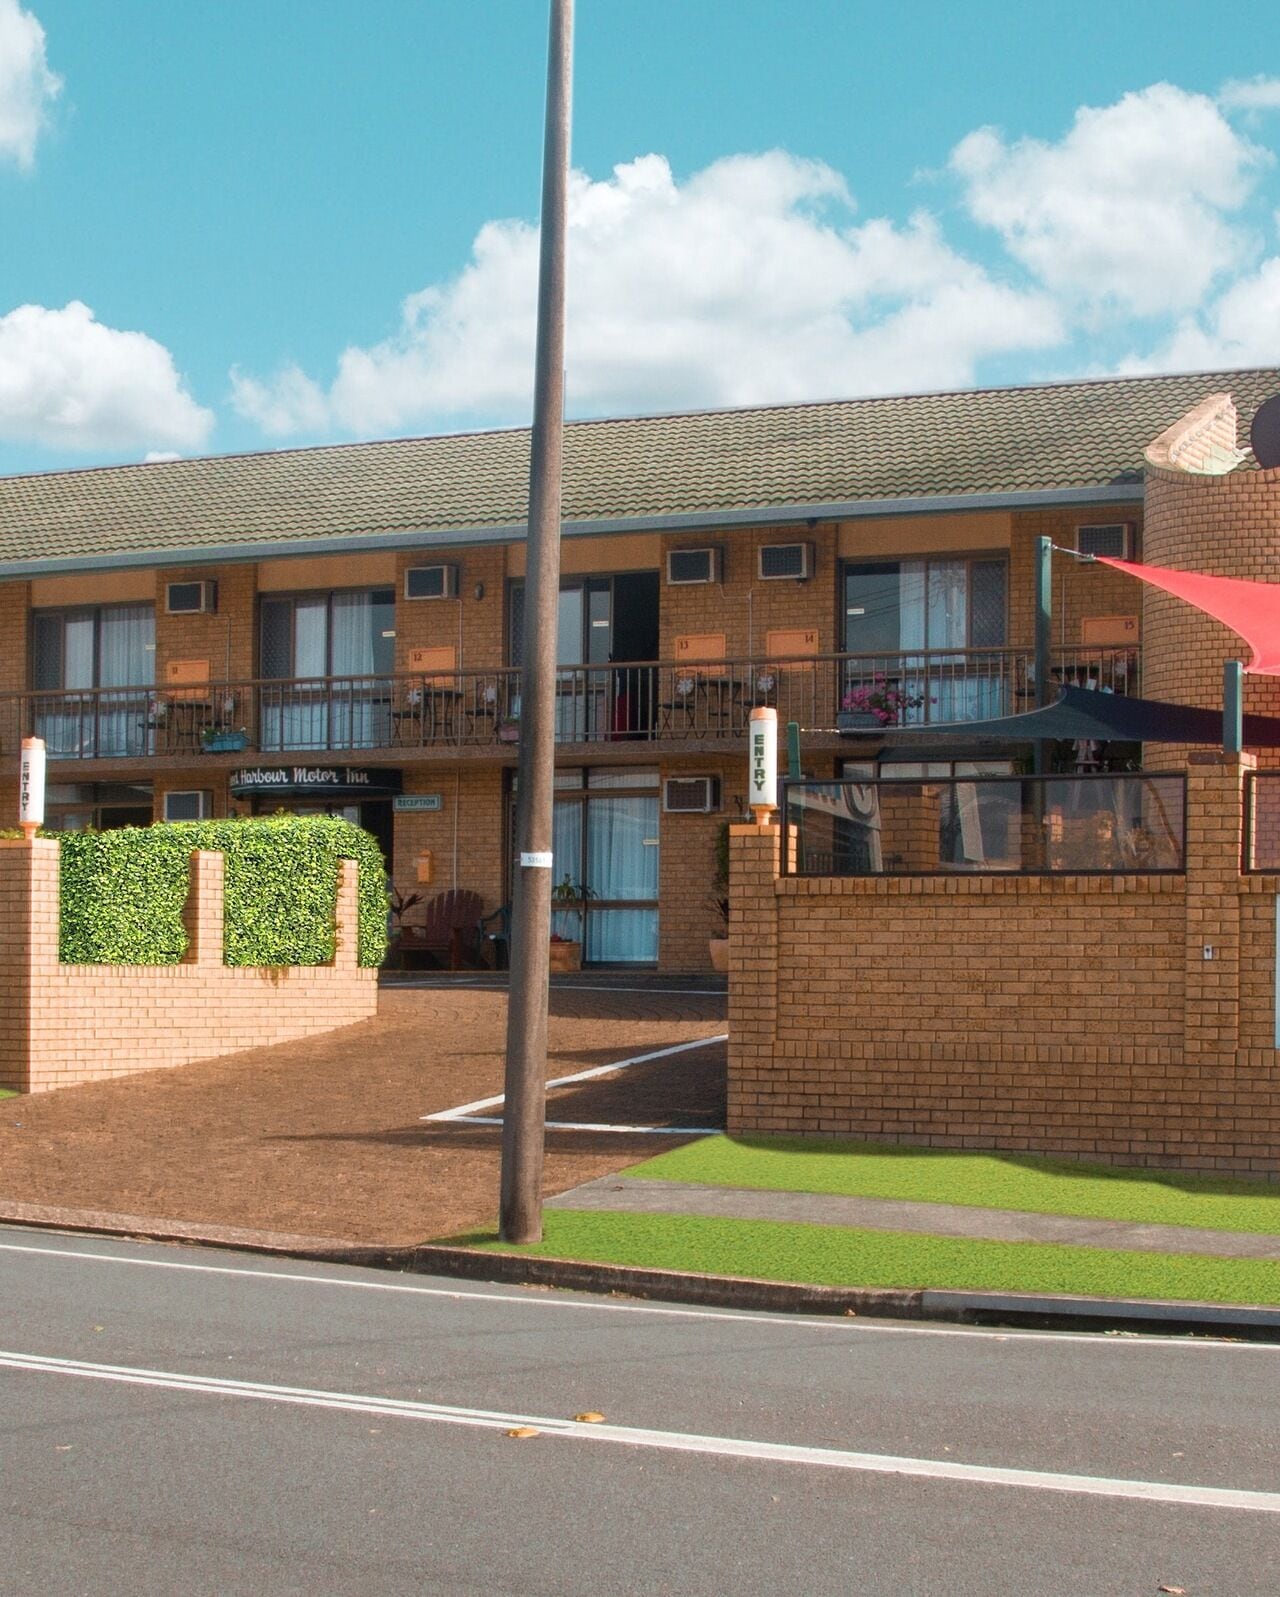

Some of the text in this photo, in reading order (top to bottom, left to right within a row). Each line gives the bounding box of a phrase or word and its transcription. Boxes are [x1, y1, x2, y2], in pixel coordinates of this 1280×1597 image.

[240, 768, 289, 785] Harbour
[293, 767, 339, 784] Motor
[346, 767, 370, 784] Inn
[754, 734, 766, 791] ENTRY
[22, 761, 30, 811] ENTRY
[397, 798, 436, 807] RECEPTION
